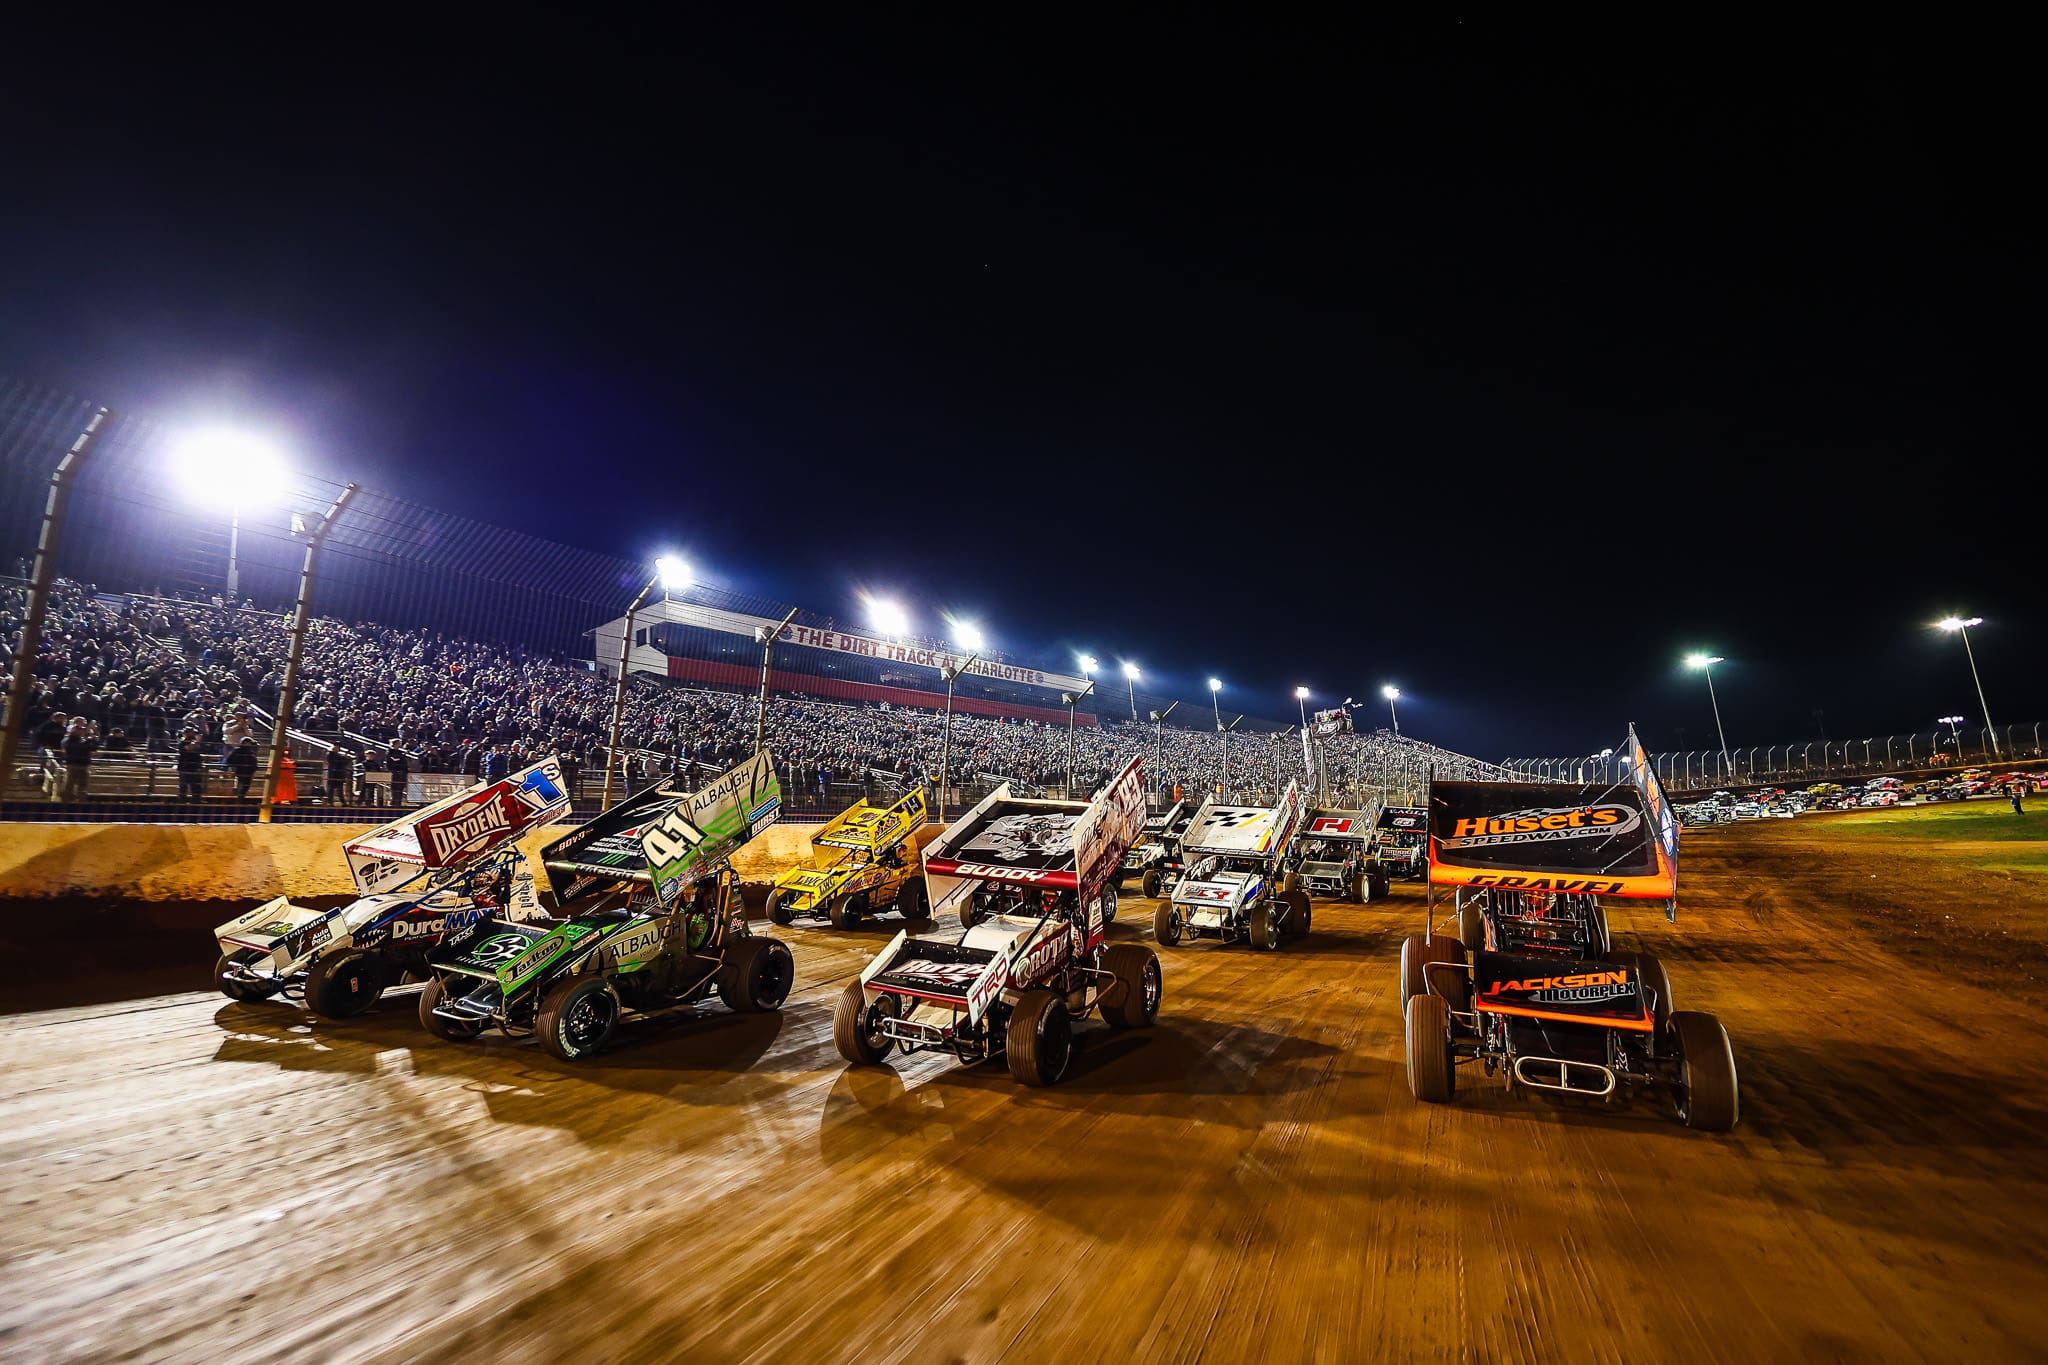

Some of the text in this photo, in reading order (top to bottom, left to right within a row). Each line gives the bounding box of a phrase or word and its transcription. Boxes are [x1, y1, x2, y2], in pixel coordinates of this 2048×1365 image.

[796, 627, 1034, 684] THE DIRT TRACK AT CHARLOTTE
[694, 767, 751, 815] ALBAUGH
[430, 794, 511, 863] DRYDENE
[1452, 806, 1619, 838] Huset's
[1460, 826, 1612, 847] SPEEDWAY.COM
[640, 810, 708, 870] 41
[955, 863, 1049, 882] BUDDY
[1469, 875, 1626, 895] GRAVEL
[312, 928, 329, 940] Auto
[608, 920, 681, 962] ALBAUGH
[1483, 970, 1628, 996] JACKSON
[1537, 981, 1637, 1002] MOTORPLEX
